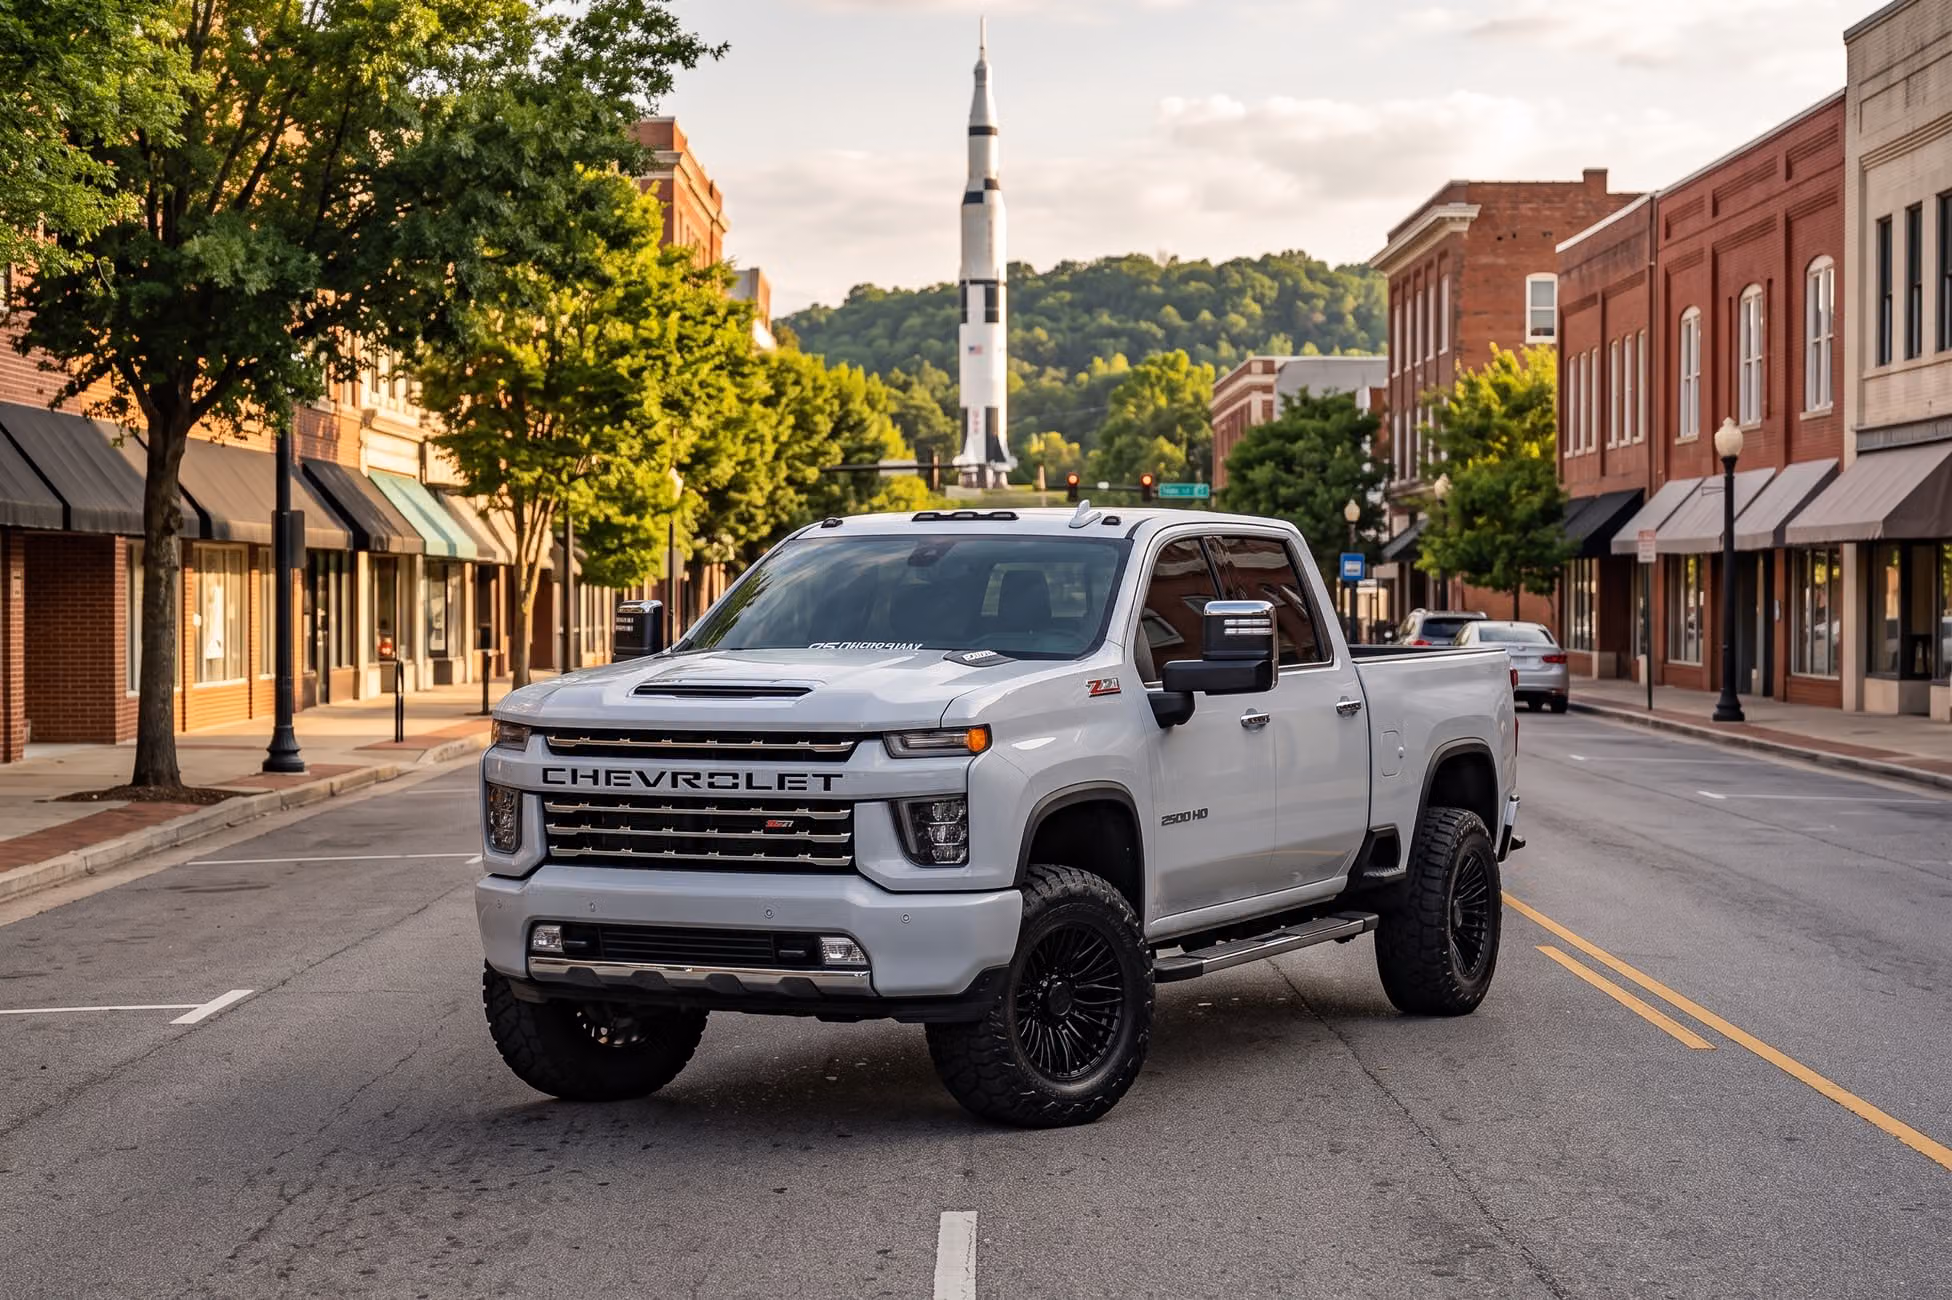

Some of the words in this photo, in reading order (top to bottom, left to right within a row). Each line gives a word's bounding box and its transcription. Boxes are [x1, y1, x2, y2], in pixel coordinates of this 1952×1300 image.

[542, 767, 844, 792] CHEVROLET
[1161, 810, 1191, 826] 2500
[1192, 807, 1209, 820] HD
